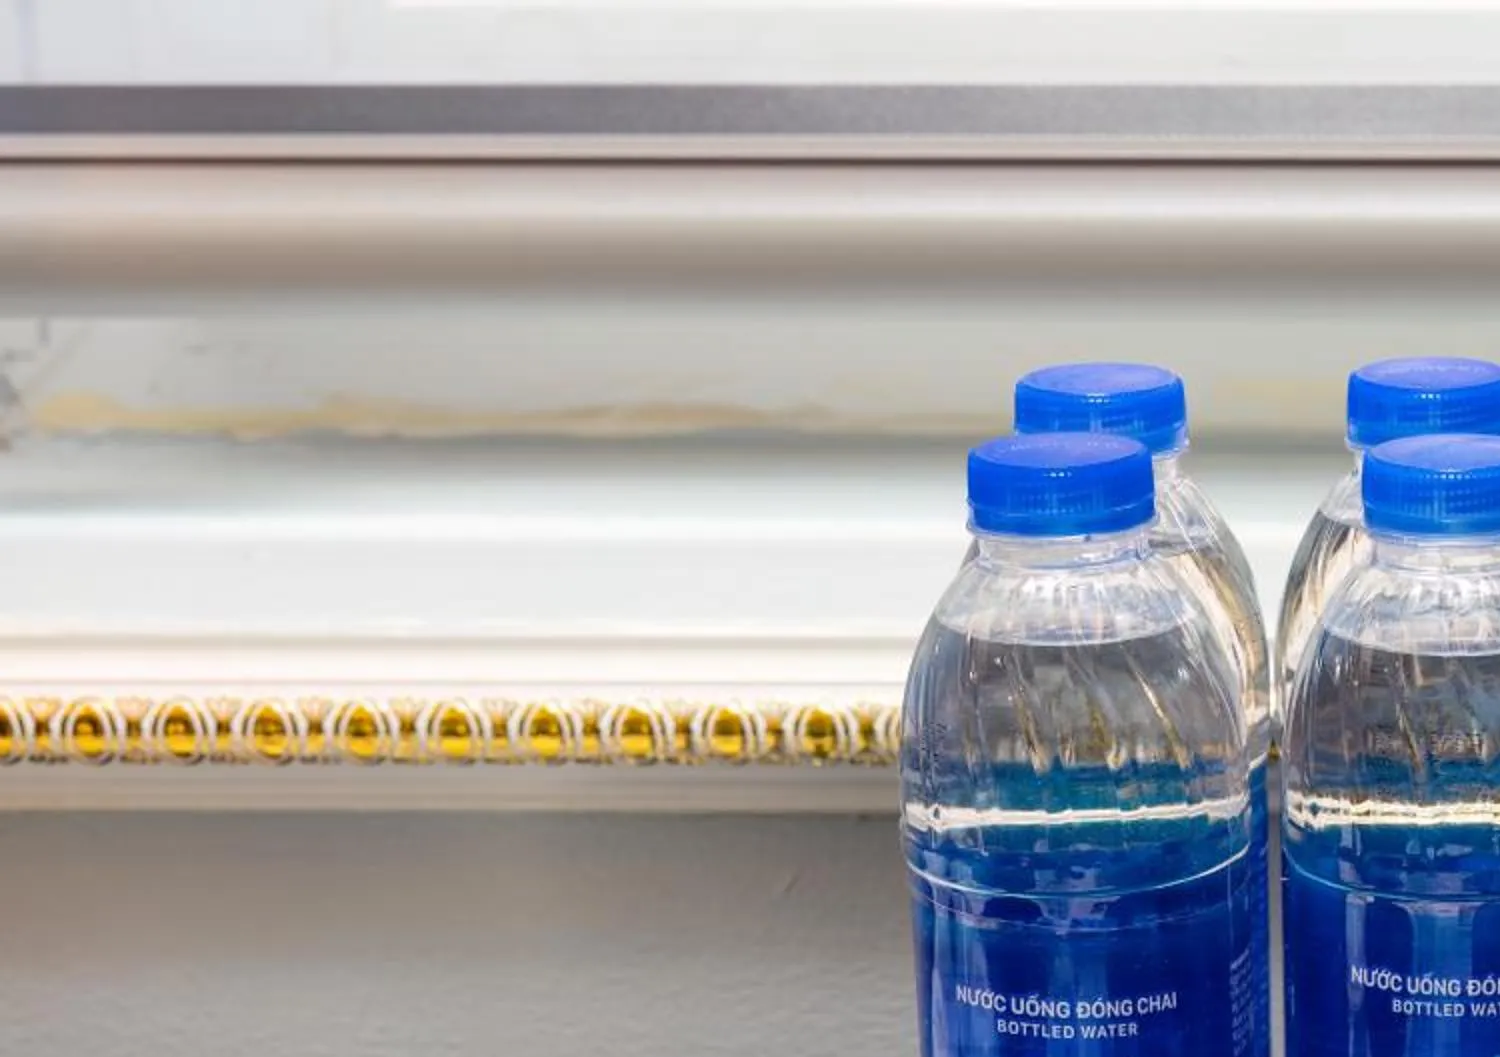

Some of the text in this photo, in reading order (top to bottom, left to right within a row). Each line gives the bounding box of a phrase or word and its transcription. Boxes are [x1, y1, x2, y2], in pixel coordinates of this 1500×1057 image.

[1351, 964, 1403, 990] NƯỚC
[1407, 972, 1461, 997] UỐNG
[955, 984, 1177, 1019] NƯỚC UỐNG ĐÓNG CHAI
[1392, 999, 1465, 1017] BOTTLED
[997, 1019, 1139, 1039] BOTTLED WATER
